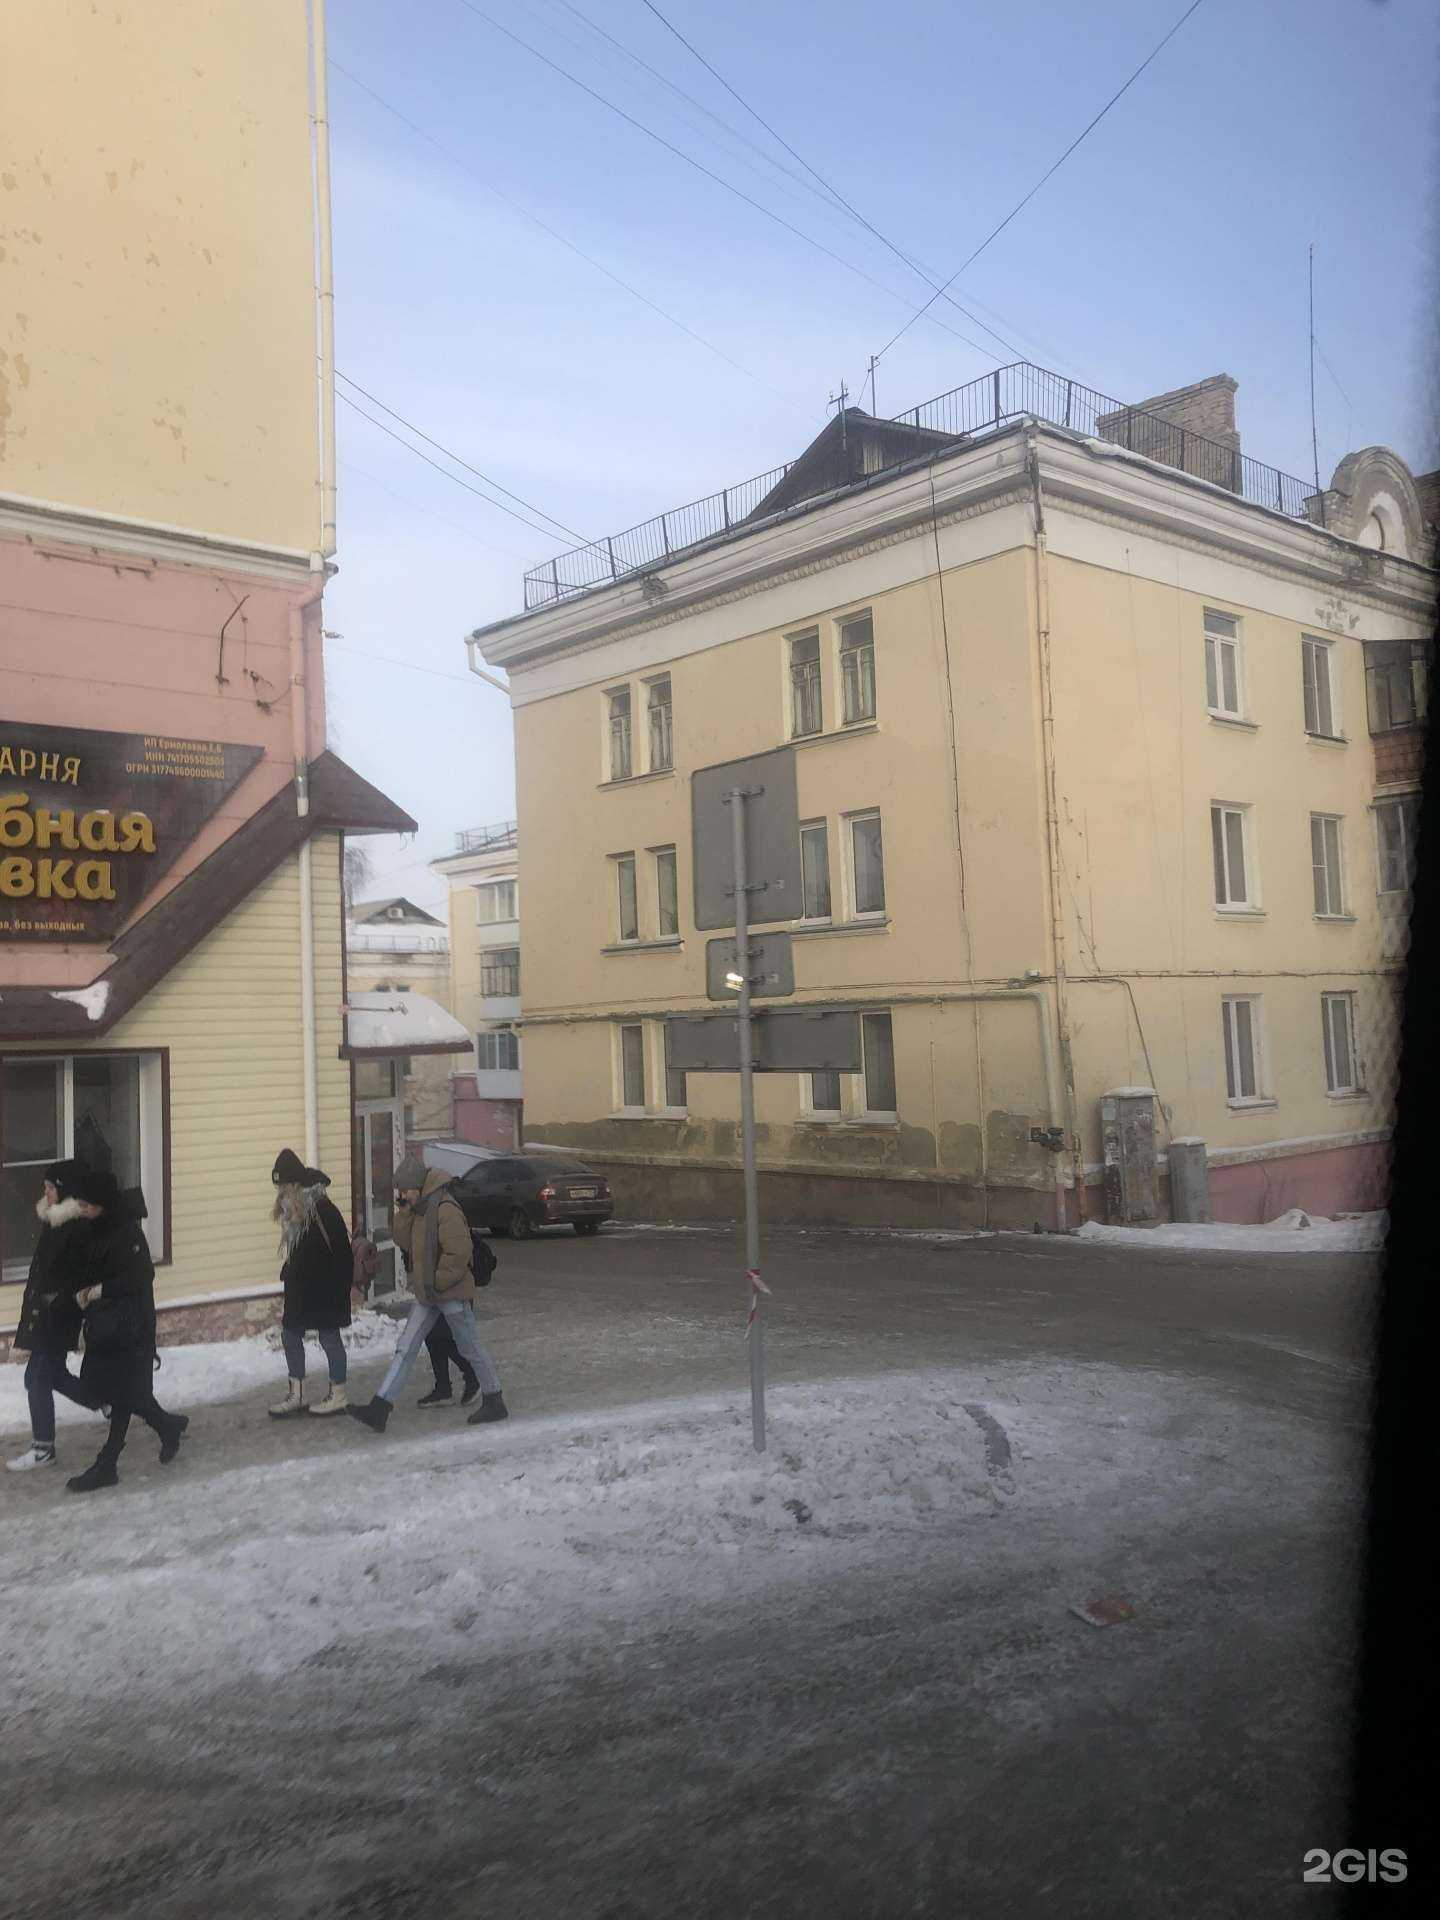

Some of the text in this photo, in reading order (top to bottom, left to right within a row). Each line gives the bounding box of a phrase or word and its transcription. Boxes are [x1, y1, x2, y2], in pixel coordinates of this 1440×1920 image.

[144, 736, 157, 749] ИП
[0, 746, 80, 786] АРНЯ
[126, 763, 150, 774] ОГРН
[0, 793, 156, 853] бная
[0, 856, 116, 900] вка
